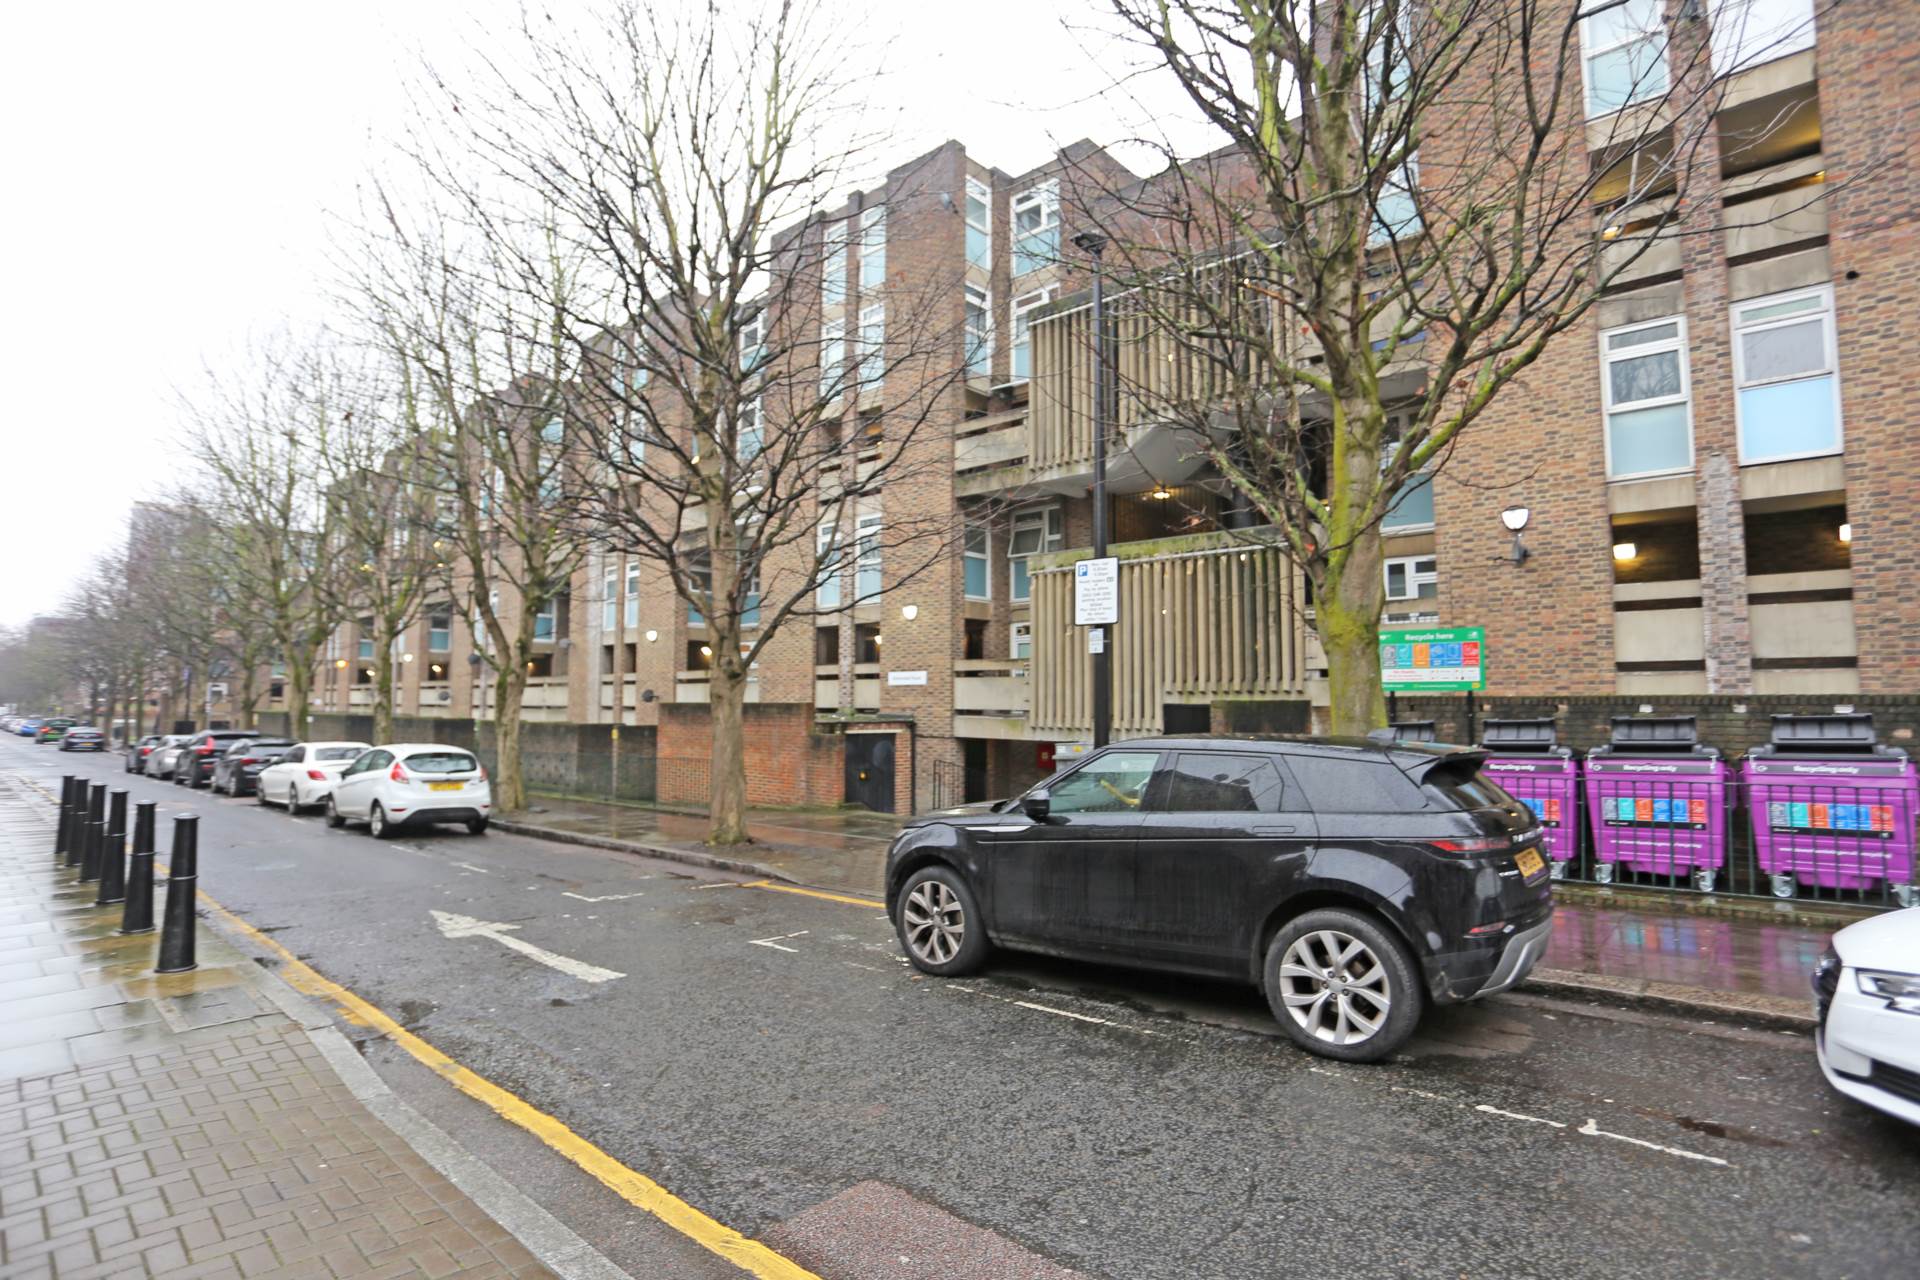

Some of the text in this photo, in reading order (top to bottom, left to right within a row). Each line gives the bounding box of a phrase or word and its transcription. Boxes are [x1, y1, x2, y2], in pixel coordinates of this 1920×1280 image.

[1079, 566, 1087, 576] P
[1405, 632, 1455, 642] Recycle here
[1623, 764, 1659, 772] Recycling
[1793, 765, 1859, 774] Recycling only
